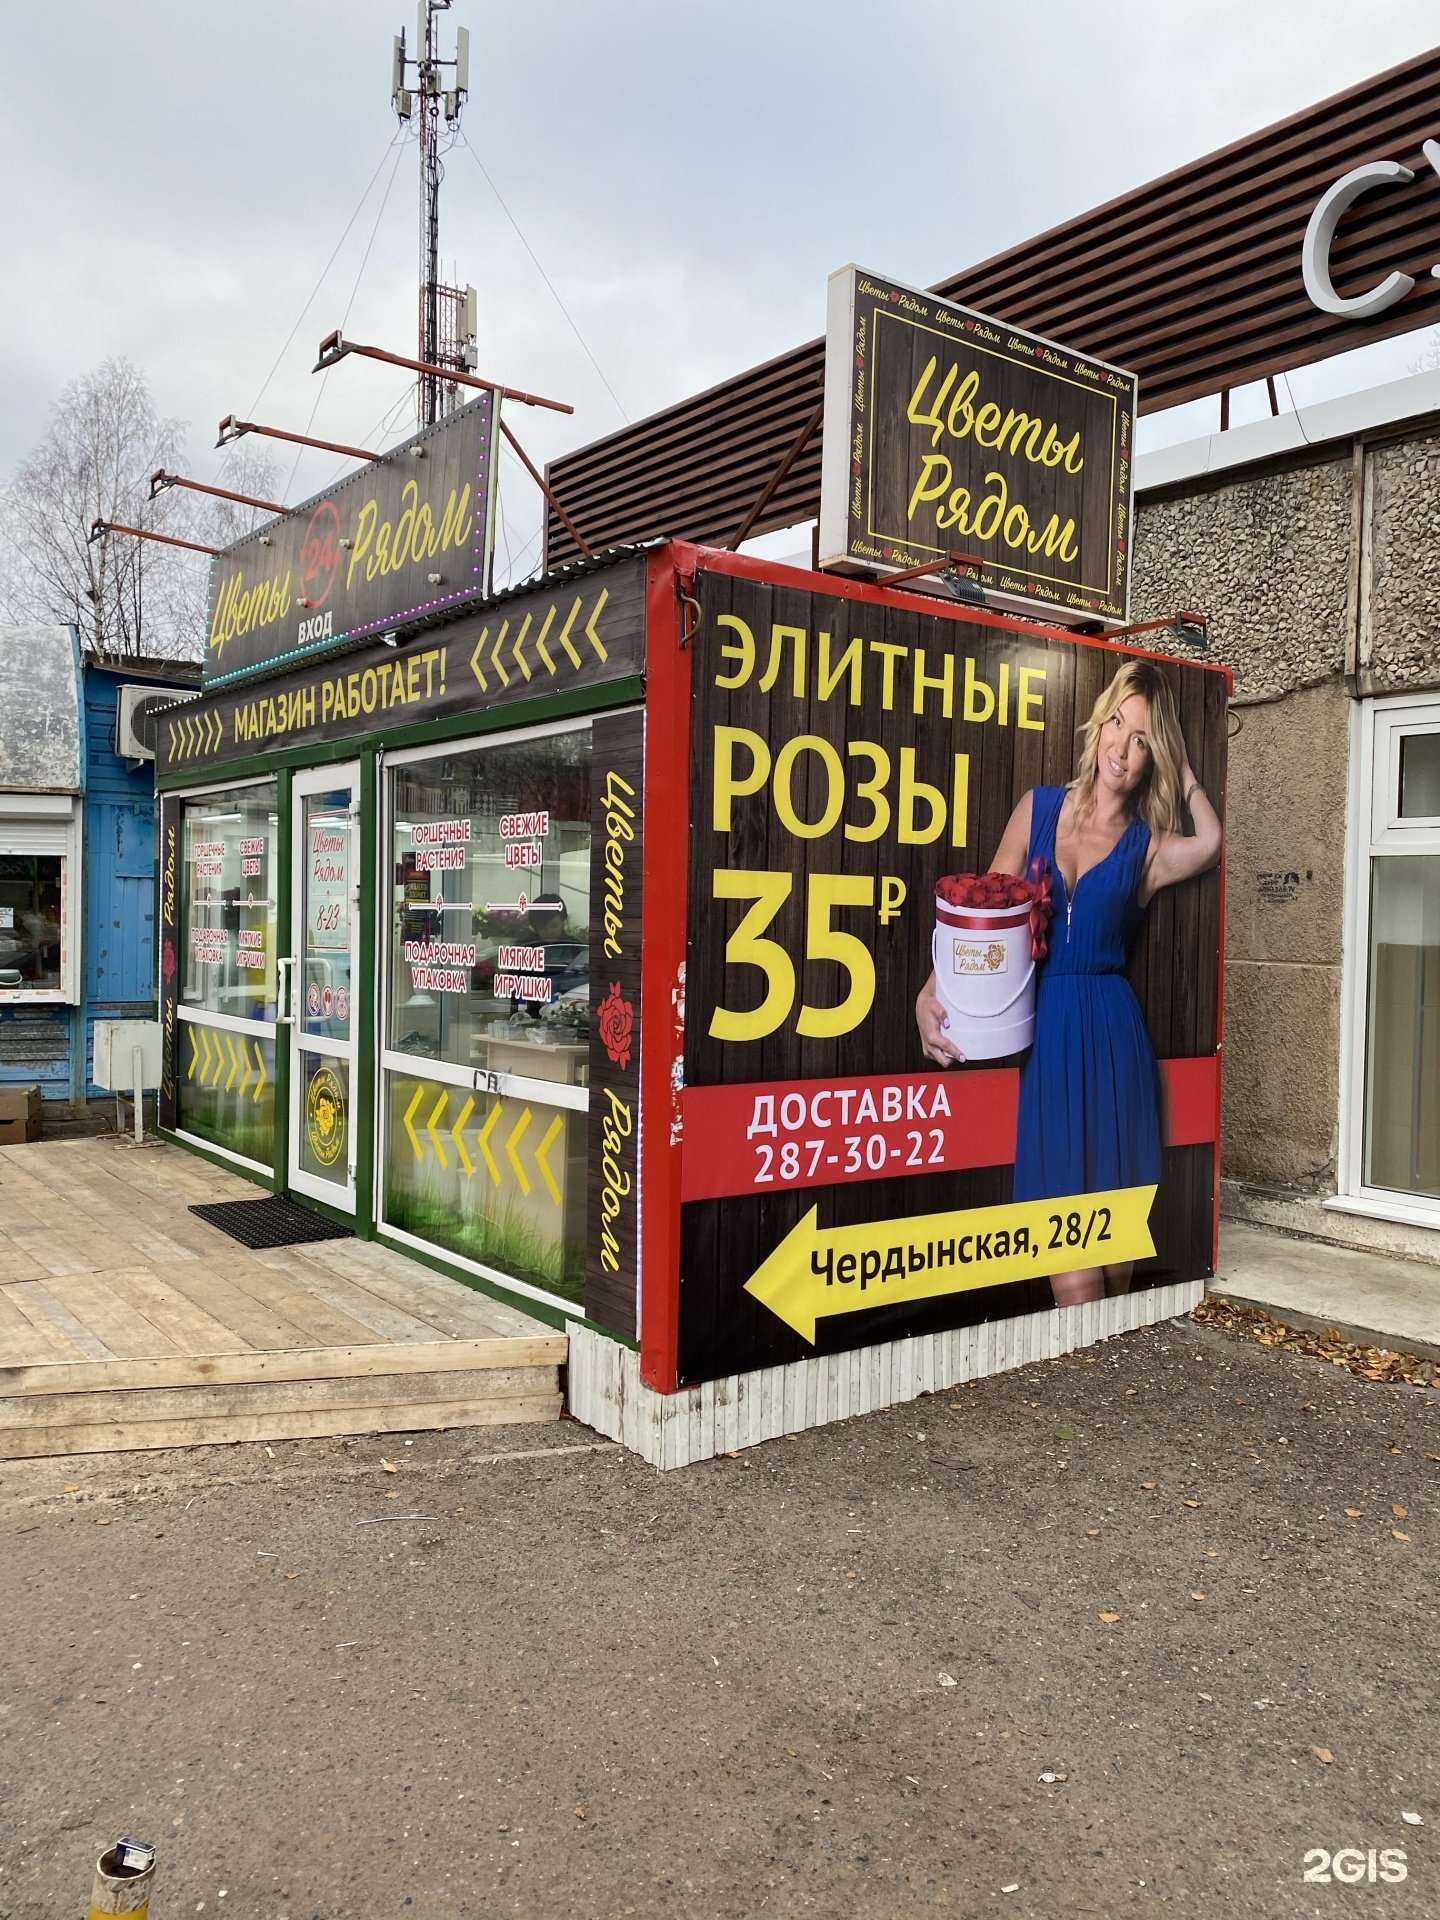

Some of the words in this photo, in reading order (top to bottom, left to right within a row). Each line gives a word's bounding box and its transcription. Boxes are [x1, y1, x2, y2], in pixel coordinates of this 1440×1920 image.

[857, 316, 867, 357] Рядом
[858, 279, 889, 301] Цветы
[898, 294, 928, 316] Рядом
[935, 309, 965, 330] Цветы
[973, 323, 1001, 343] Рядом
[1008, 337, 1035, 358] Цветы
[1042, 350, 1068, 368] Рядом
[1074, 362, 1099, 381] Цветы
[1107, 374, 1131, 392] Рядом
[855, 370, 865, 412] Цветы
[907, 355, 1083, 474] Цветы
[853, 423, 864, 464] Рядом
[851, 476, 862, 519] Цветы
[908, 454, 1078, 562] Рядом
[347, 479, 472, 591] Рядом
[851, 540, 882, 558] Цветы
[891, 549, 920, 567] Рядом
[1000, 576, 1027, 593] Цветы
[1035, 584, 1060, 600] Рядом
[1066, 592, 1091, 608] Цветы
[1099, 600, 1122, 615] Рядом
[210, 570, 290, 660] Цветы
[298, 611, 332, 644] ВХОД
[715, 614, 1047, 731] ЭЛИТНЫЕ
[234, 686, 315, 743] МАГАЗИН
[322, 648, 447, 723] РАБОТАЕТ!
[713, 725, 970, 848] РОЗЫ
[313, 831, 344, 855] Цветы
[411, 820, 470, 844] ГОРШЕЧНЫЕ
[500, 811, 548, 838] СВЕЖИЕ
[240, 838, 264, 855] СВЕЖИЕ
[416, 848, 465, 871] РАСТЕНИЯ
[505, 843, 542, 869] ЦВЕТЫ
[600, 771, 635, 959] Цветы
[164, 825, 175, 926] Рядом
[242, 858, 260, 877] ЦВЕТЫ
[314, 858, 344, 881] Рядом
[317, 904, 339, 930] 8-23
[236, 950, 265, 968] ИГРУШКИ
[405, 941, 475, 966] ПОДАРОЧНАЯ
[499, 946, 544, 971] МЯГКИЕ
[412, 968, 466, 992] УПАКОВКА
[494, 975, 551, 1002] ИГРУШКИ
[746, 1083, 951, 1140] ДОСТАВКА
[753, 1129, 945, 1184] 287-30-22
[601, 1088, 631, 1272] Рядом
[811, 1223, 1039, 1291] Чердынская,
[1047, 1207, 1112, 1251] 28/2
